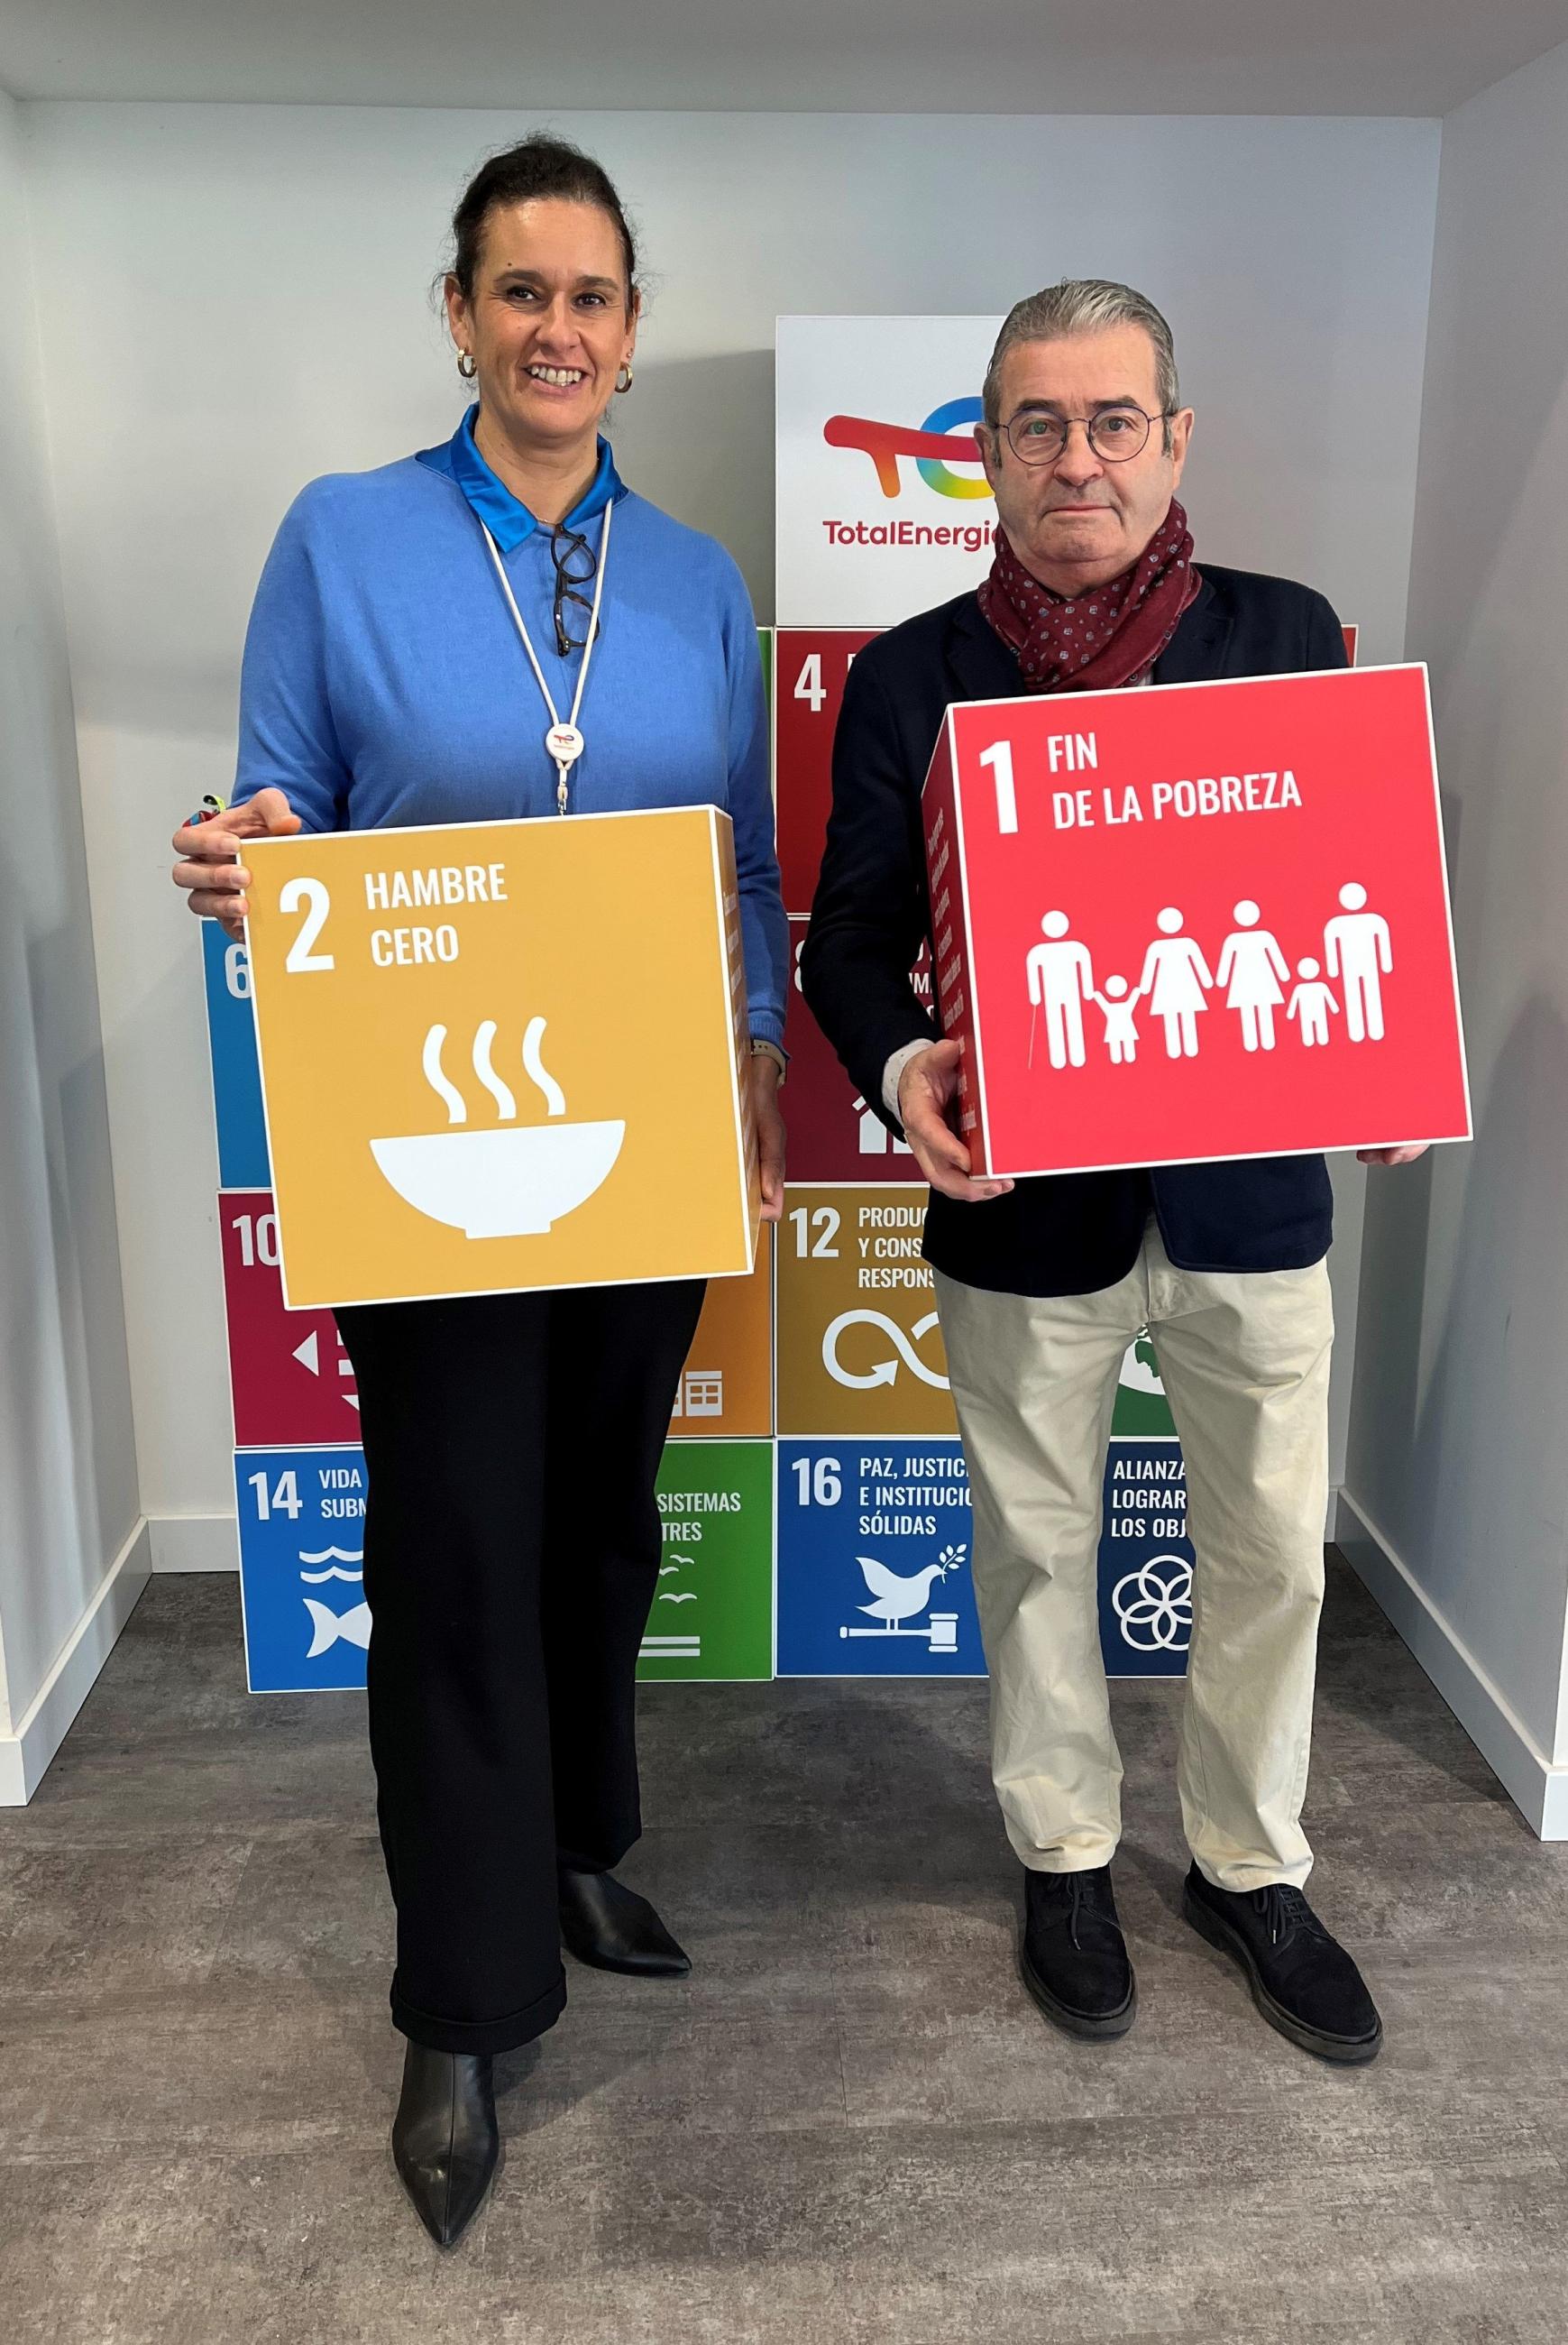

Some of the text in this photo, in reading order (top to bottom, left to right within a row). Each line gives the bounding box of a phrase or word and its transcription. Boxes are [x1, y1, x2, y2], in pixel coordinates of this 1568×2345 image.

[822, 520, 996, 552] TotalEnergi
[794, 654, 826, 711] 4
[1048, 732, 1097, 772] FIN
[980, 740, 1018, 833] 1
[1053, 771, 1302, 829] DE LA POBREZA
[365, 863, 508, 909] HAMBRE
[280, 877, 335, 972] 2
[371, 925, 459, 966] CERO
[225, 943, 251, 998] 6
[233, 1214, 280, 1266] 10
[790, 1207, 840, 1257] 12
[858, 1237, 922, 1257] Y CONS
[318, 1468, 362, 1489] VIDA
[793, 1457, 842, 1505] 16
[859, 1458, 898, 1479] PAZ,
[248, 1471, 303, 1521] 14
[656, 1493, 741, 1513] SISTEMAS
[859, 1486, 869, 1505] E
[1112, 1489, 1187, 1509] LOGRAR
[661, 1522, 702, 1541] TRES
[858, 1510, 936, 1535] SÓLIDAS
[1111, 1518, 1146, 1538] LOS
